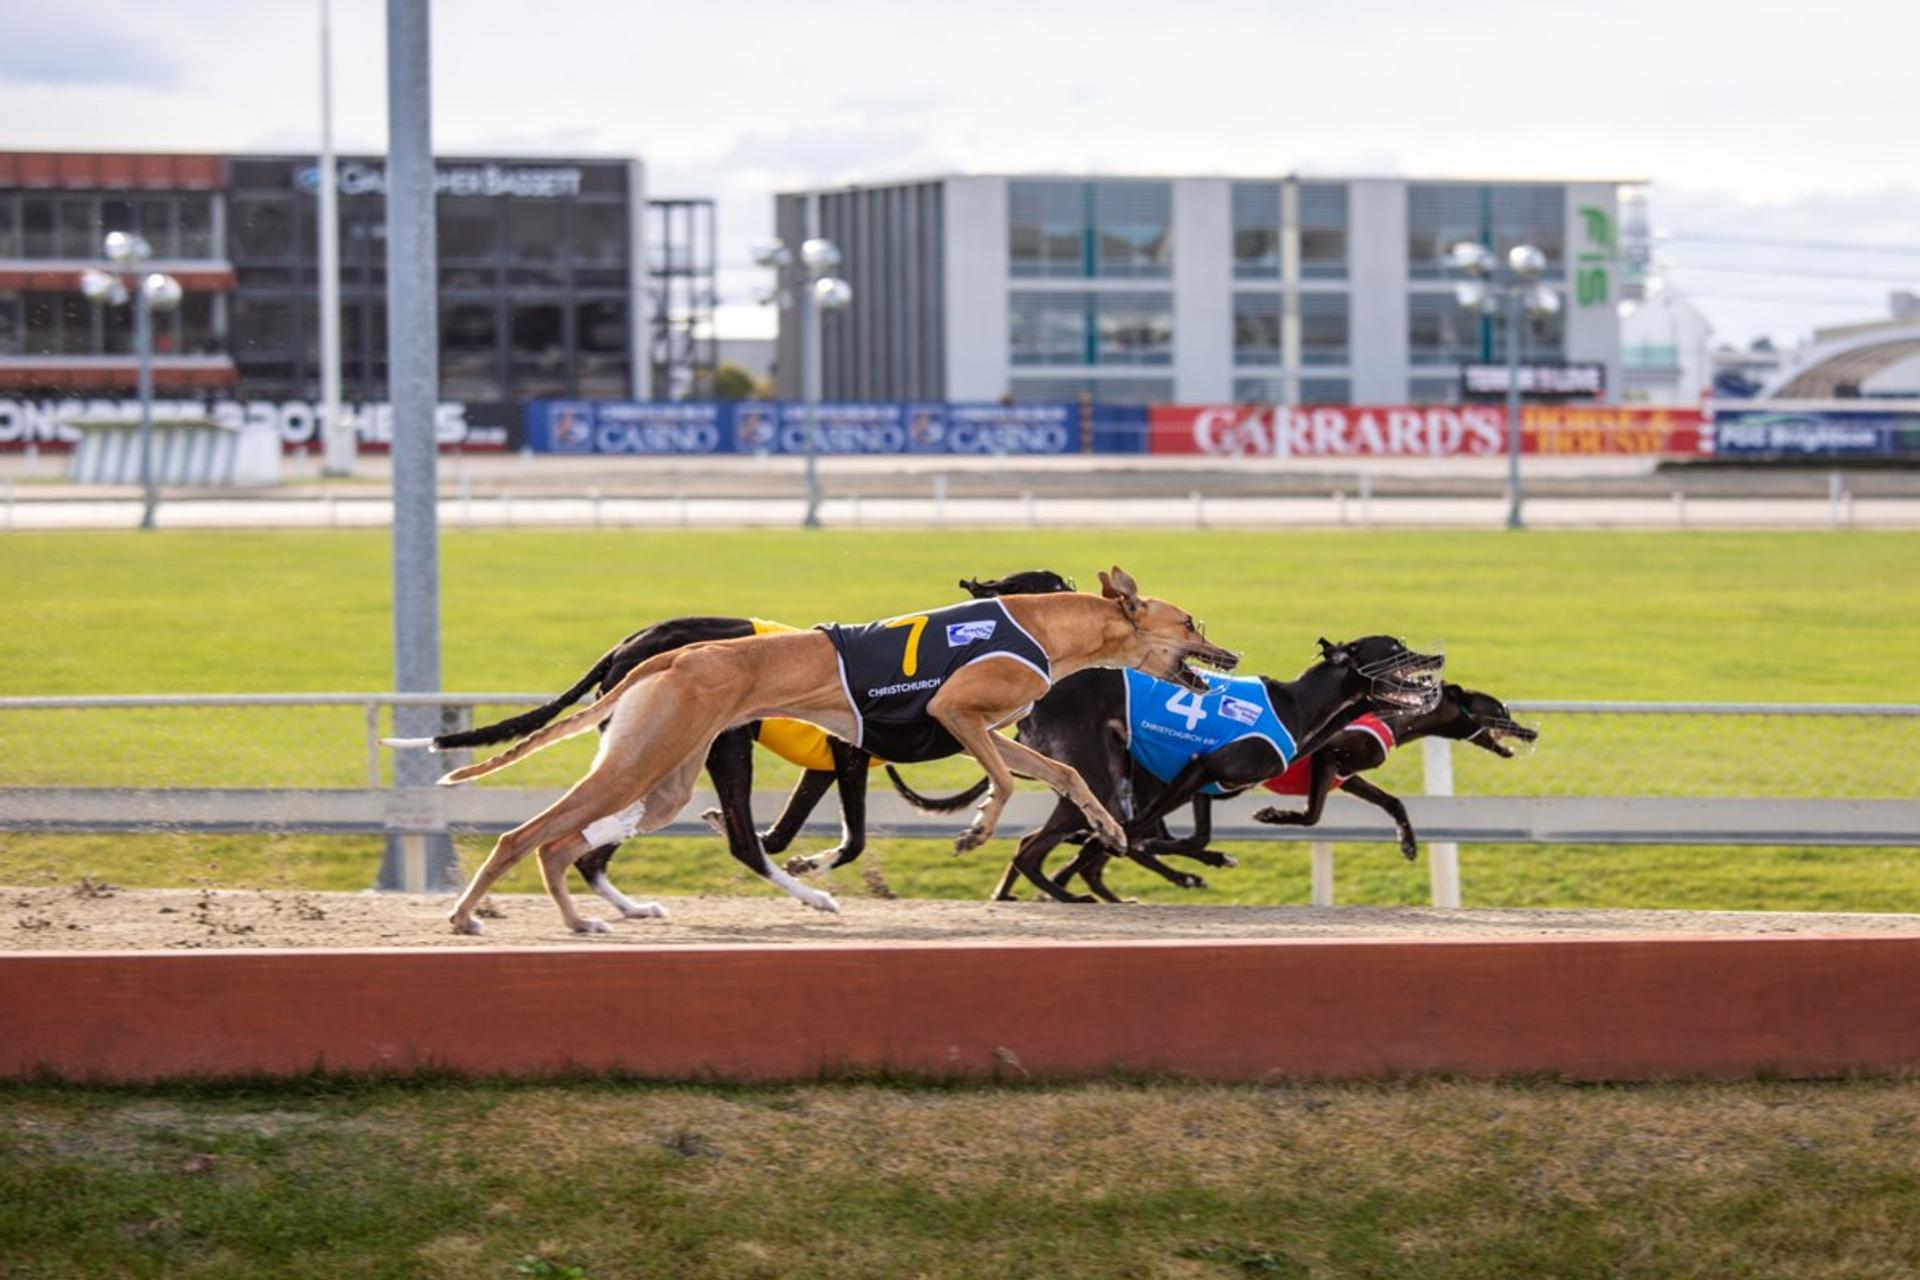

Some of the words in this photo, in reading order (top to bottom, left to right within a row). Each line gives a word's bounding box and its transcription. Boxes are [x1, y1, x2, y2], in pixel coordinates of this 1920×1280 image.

[597, 423, 719, 452] CASINO
[949, 423, 1067, 452] CASINO
[1193, 406, 1503, 457] GARRARD'S
[885, 615, 930, 678] 7
[867, 677, 942, 699] CHRISTCHURCH
[1164, 686, 1208, 731] 4
[1140, 719, 1202, 744] CHRISTCHURCH
